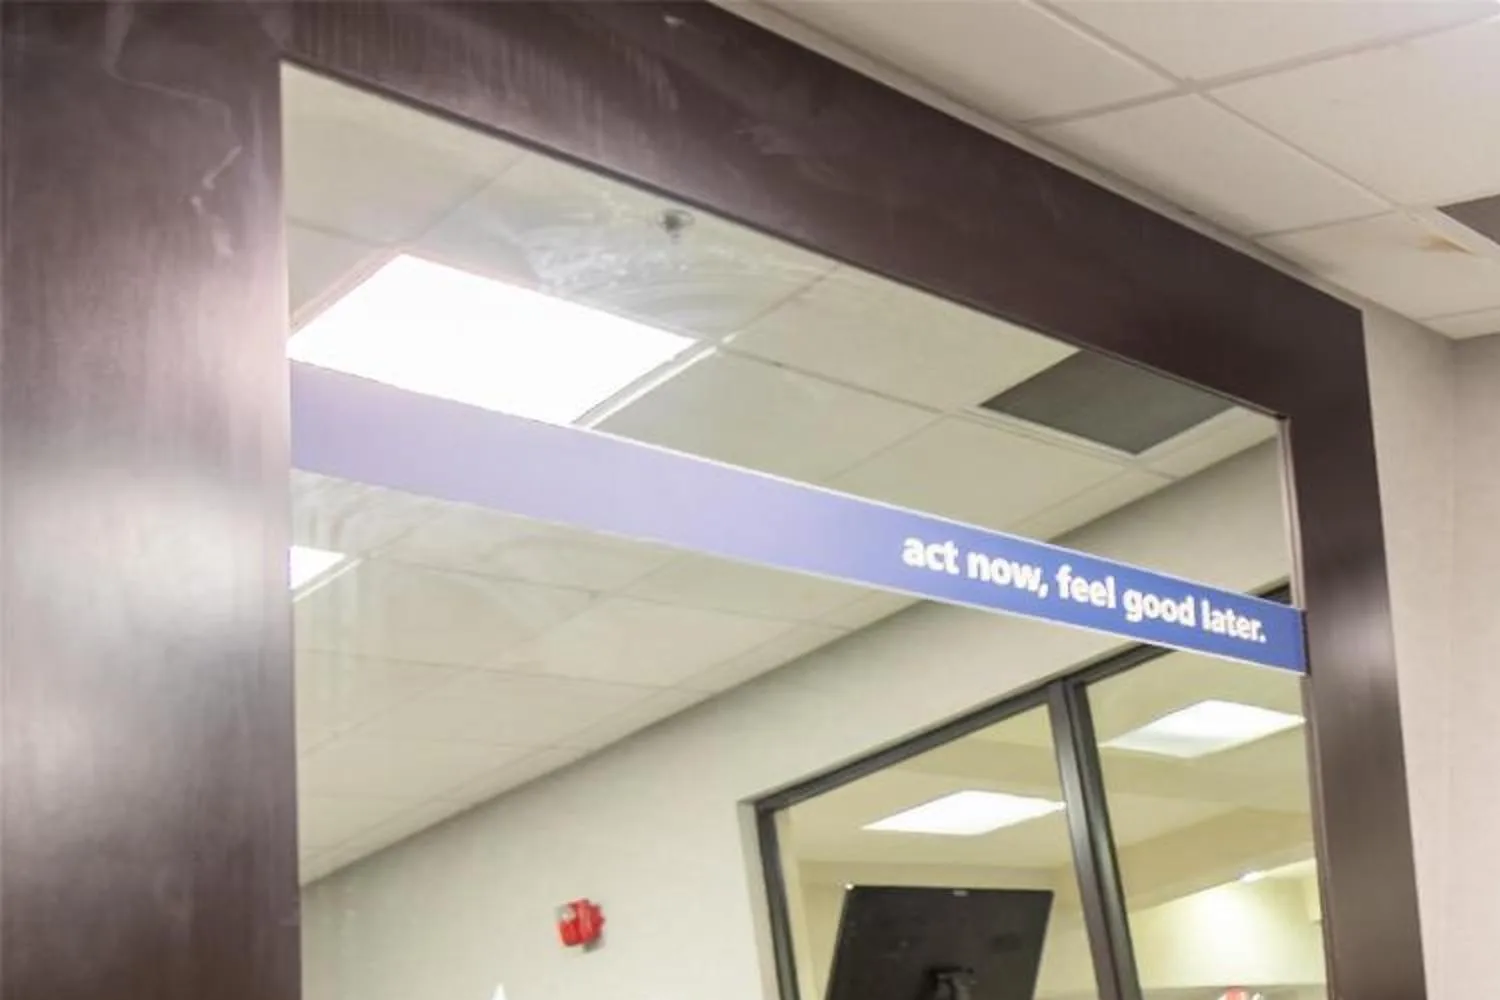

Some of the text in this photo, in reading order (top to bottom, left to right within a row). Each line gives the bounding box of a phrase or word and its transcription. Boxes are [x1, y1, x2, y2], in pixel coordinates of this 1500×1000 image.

[902, 536, 1267, 643] act now, feel good later.
